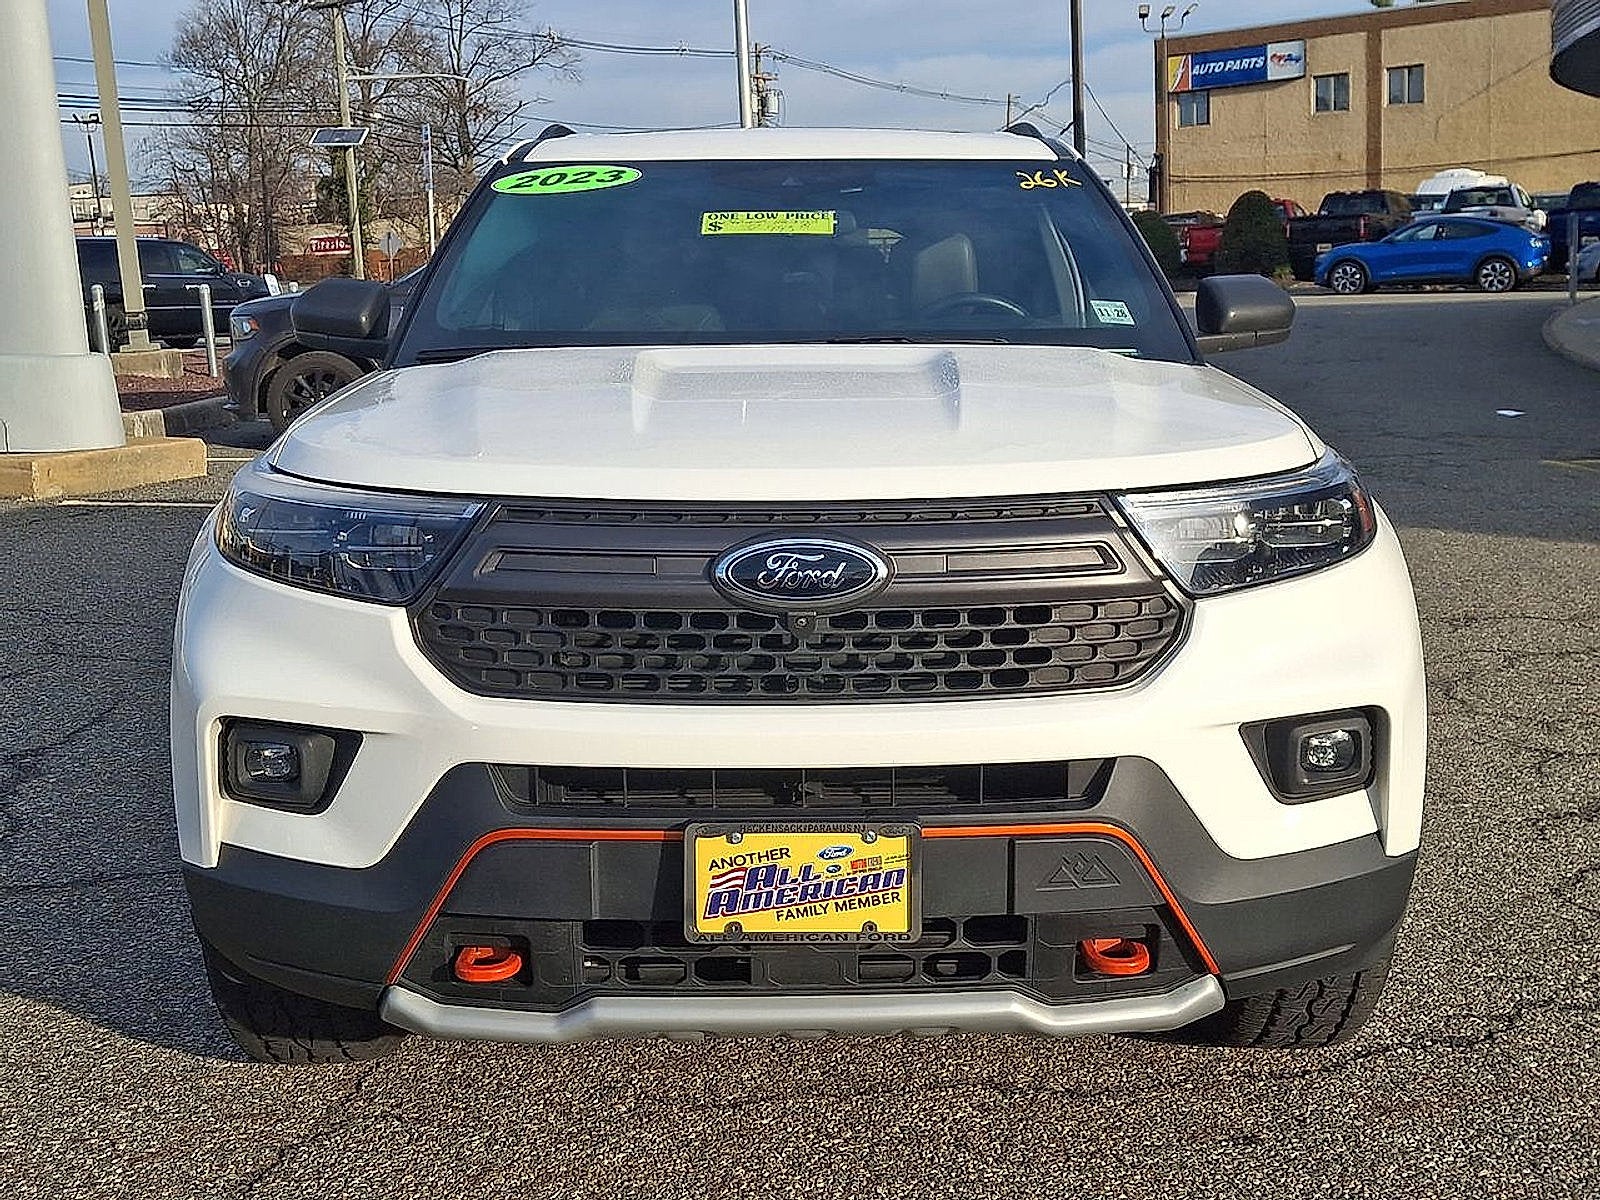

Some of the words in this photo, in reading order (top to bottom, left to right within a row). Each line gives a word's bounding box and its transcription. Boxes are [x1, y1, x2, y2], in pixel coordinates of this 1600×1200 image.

[1192, 61, 1224, 76] AUTO
[1225, 56, 1265, 72] PARTS
[507, 170, 627, 190] 2023
[1016, 169, 1082, 189] 26K
[707, 212, 739, 221] ONE
[746, 212, 779, 220] LOW
[785, 212, 829, 220] PRICE
[757, 552, 847, 589] Ford
[708, 847, 791, 872] ANOTHER
[823, 847, 847, 860] Ford
[744, 863, 822, 891] ALL
[706, 868, 906, 916] AMERICAN
[775, 902, 830, 921] FAMILY
[834, 891, 902, 913] MEMBER
[696, 933, 737, 942] ALL
[741, 933, 849, 942] AMERICAN
[857, 932, 912, 942] FORD
